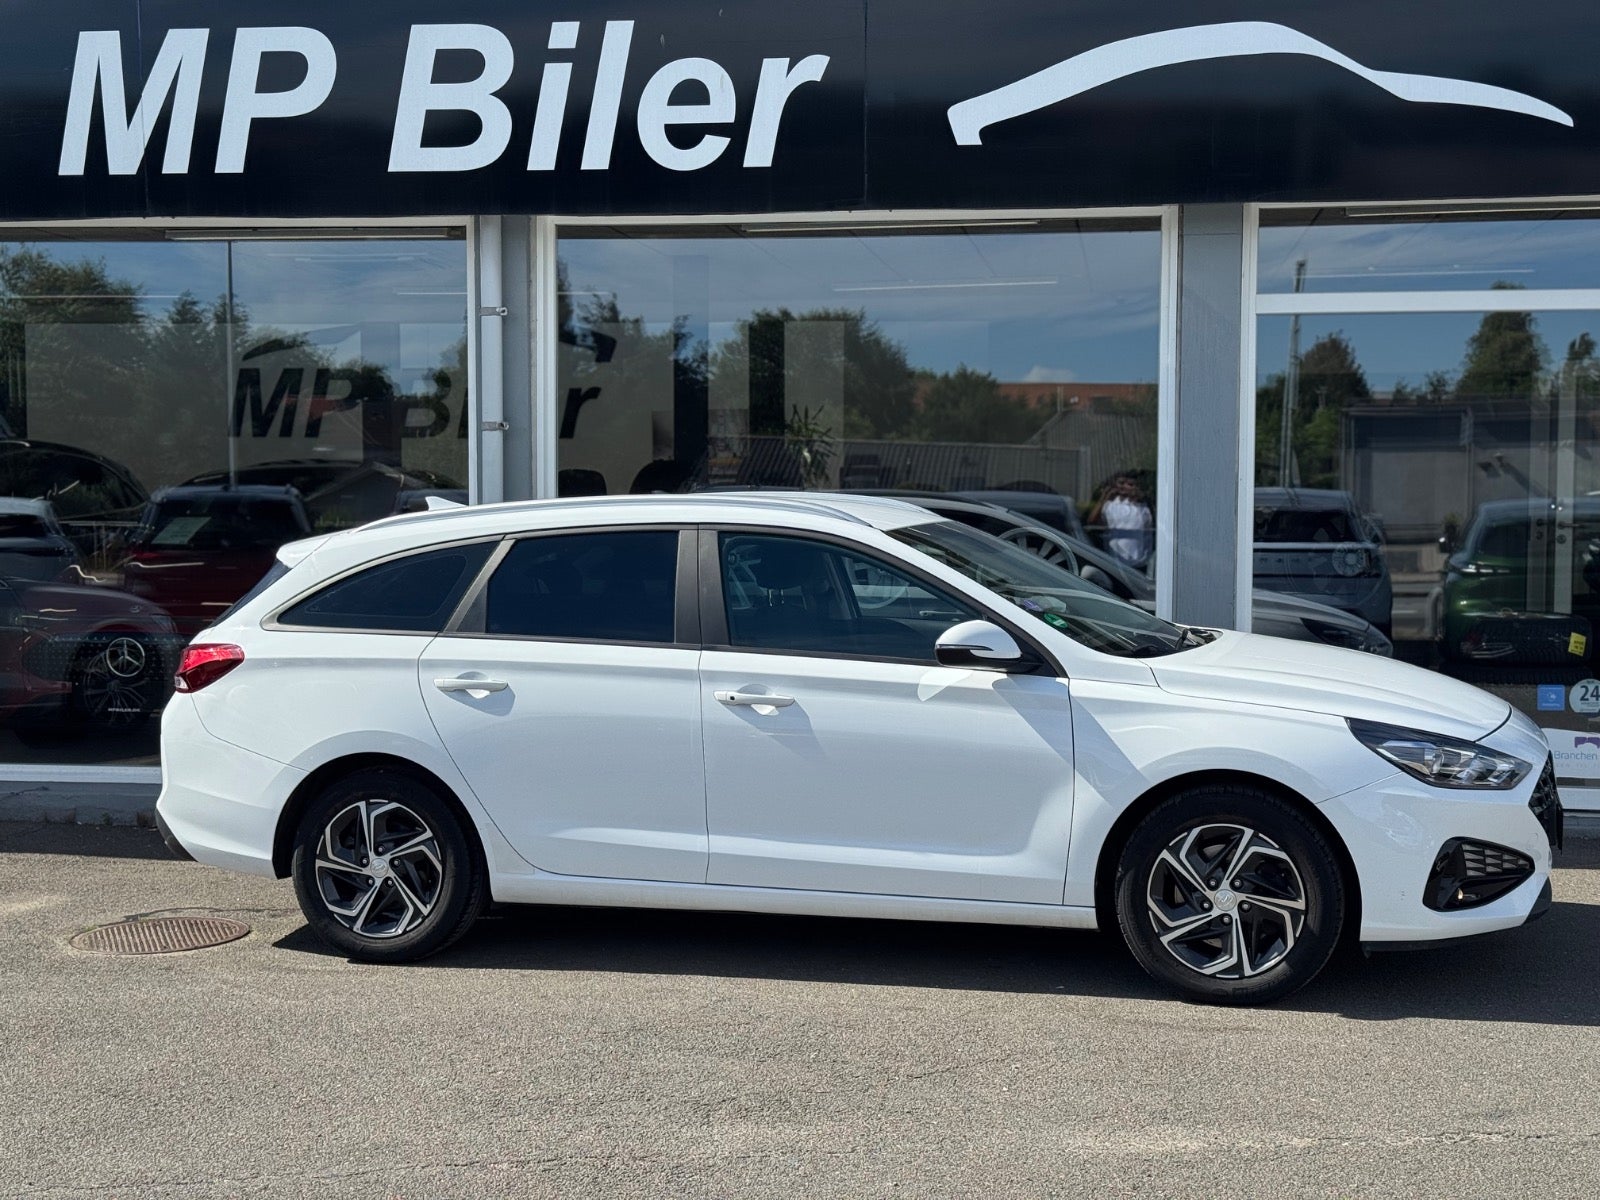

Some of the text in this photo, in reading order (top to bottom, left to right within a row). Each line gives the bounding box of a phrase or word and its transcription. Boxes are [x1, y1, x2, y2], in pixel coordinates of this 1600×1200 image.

[58, 20, 830, 176] MP Biler
[231, 367, 361, 438] MP
[1580, 685, 1600, 701] 24
[1553, 750, 1598, 761] Branchen
